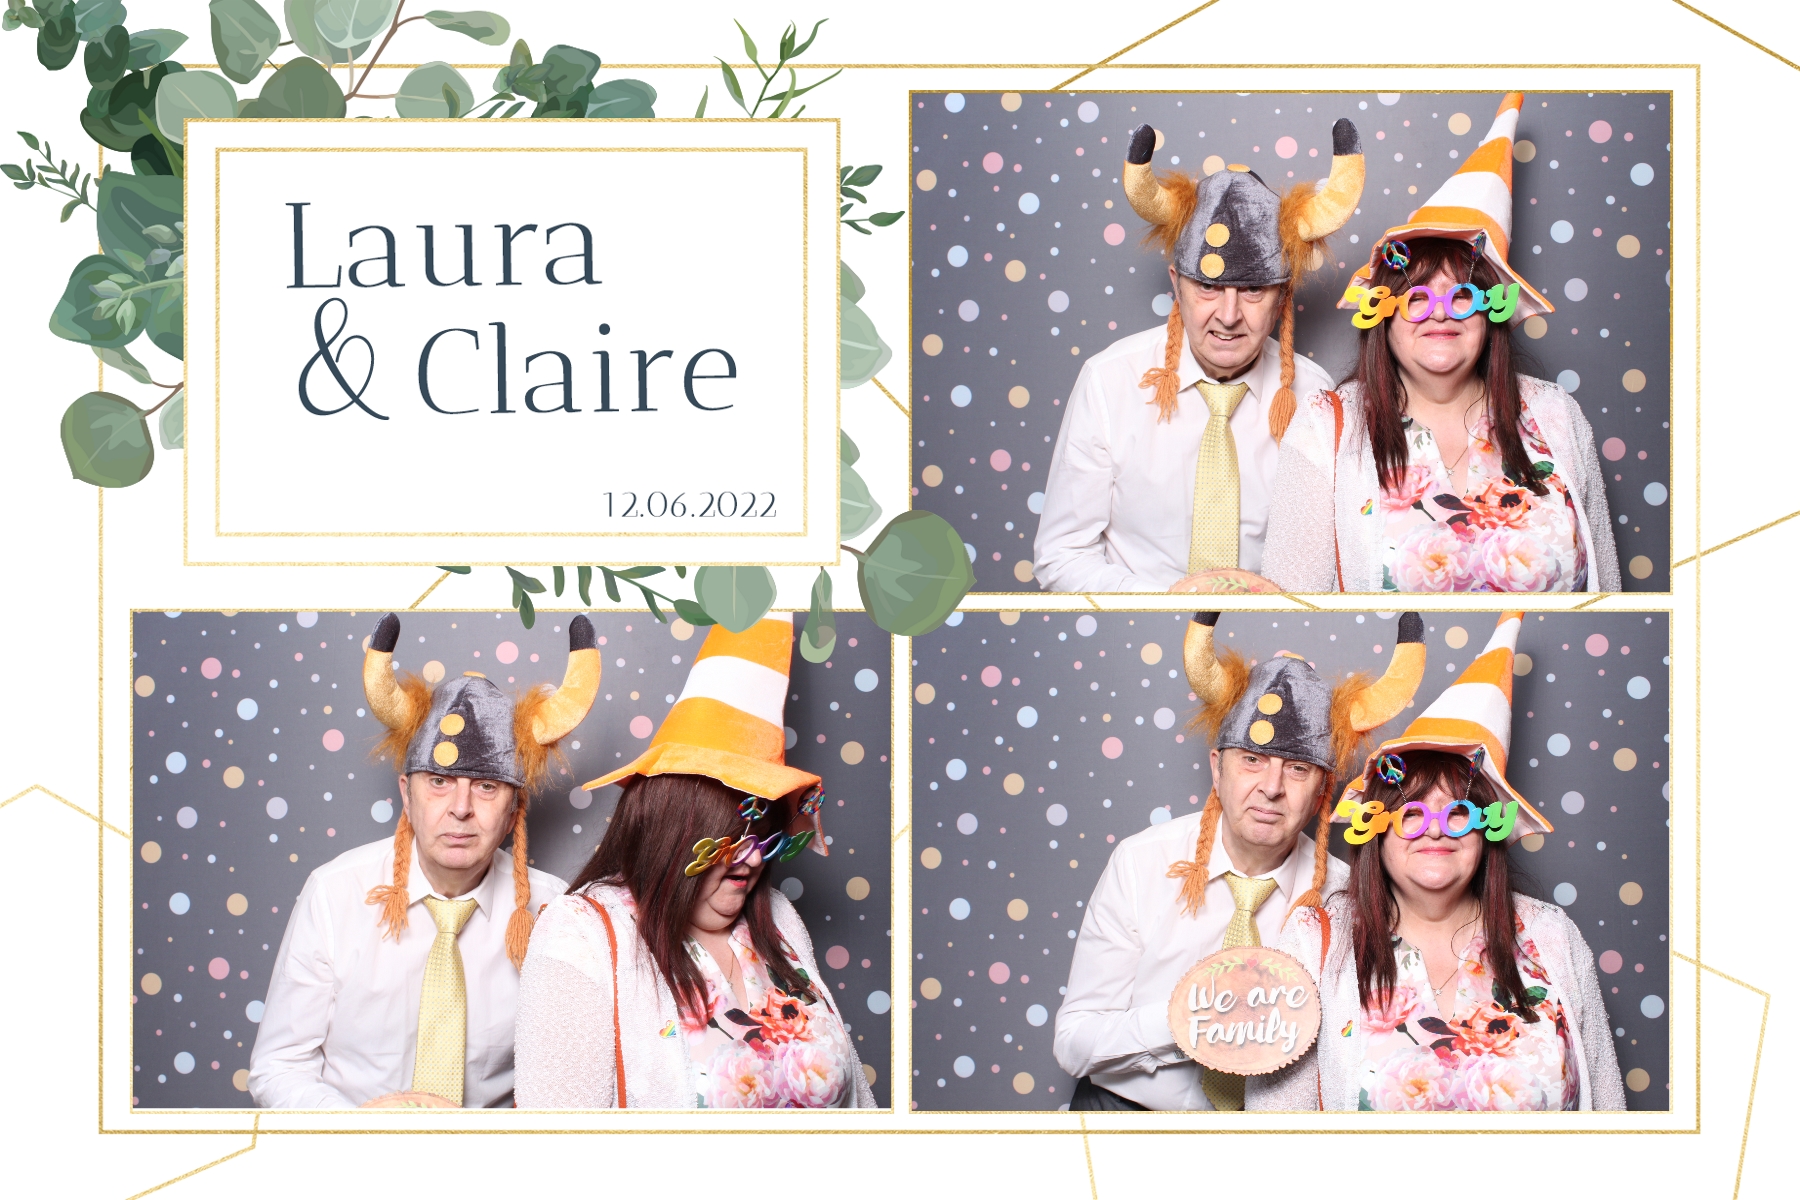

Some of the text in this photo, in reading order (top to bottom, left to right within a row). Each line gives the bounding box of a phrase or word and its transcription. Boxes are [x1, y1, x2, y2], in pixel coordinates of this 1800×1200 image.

[1188, 975, 1310, 1013] We are
[1187, 1007, 1300, 1053] Family
